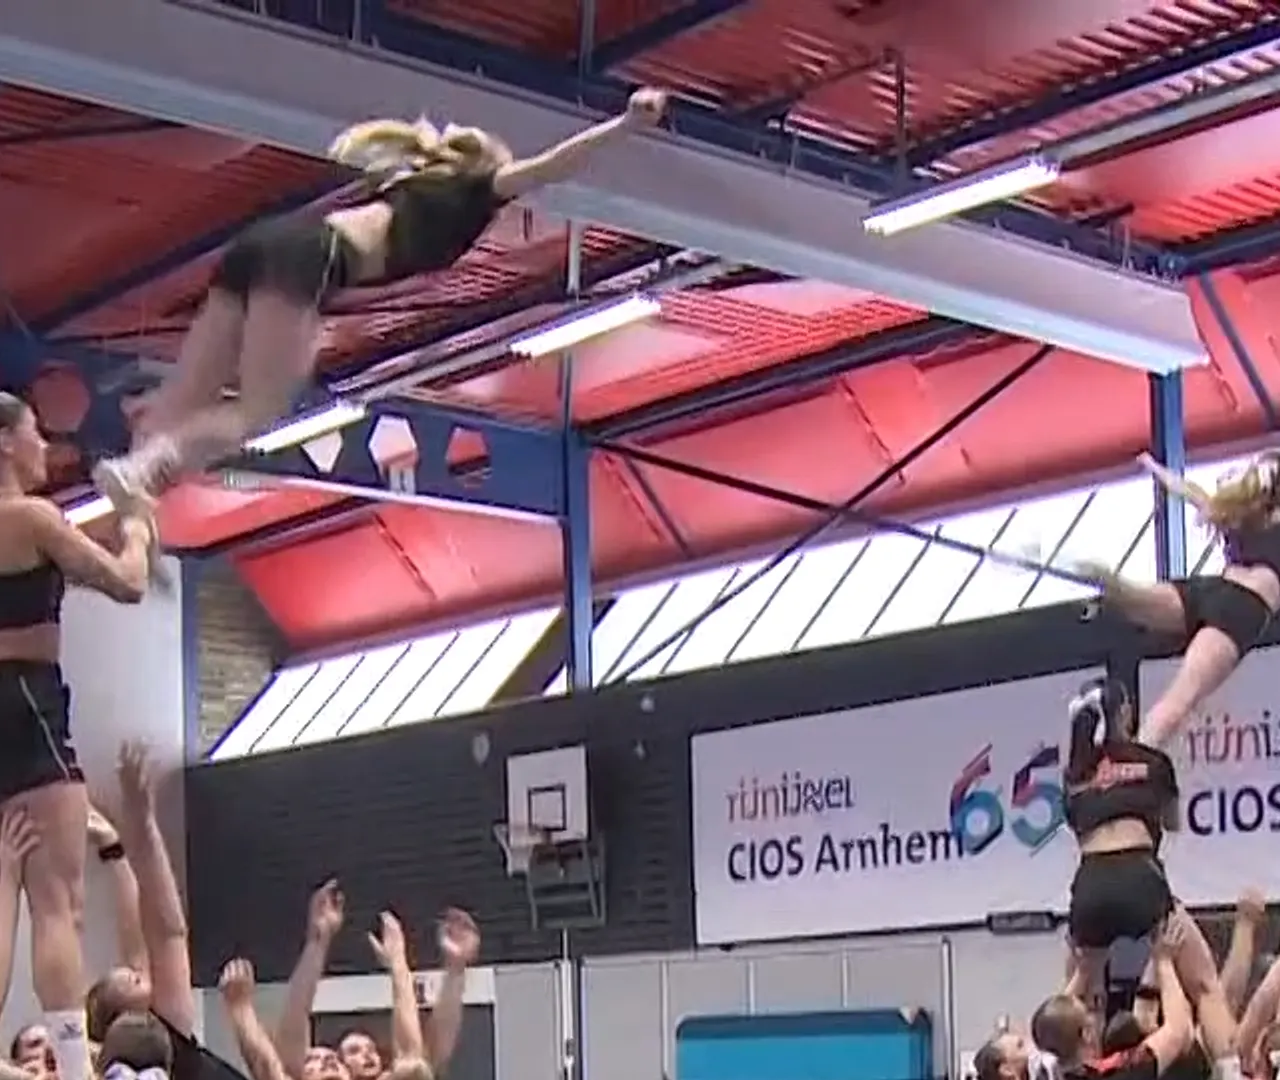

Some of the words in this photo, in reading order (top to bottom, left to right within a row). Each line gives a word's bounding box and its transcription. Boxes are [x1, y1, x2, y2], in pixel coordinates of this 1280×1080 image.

[950, 743, 1069, 857] 65
[727, 835, 803, 881] CIOS
[814, 823, 964, 874] Arnhem
